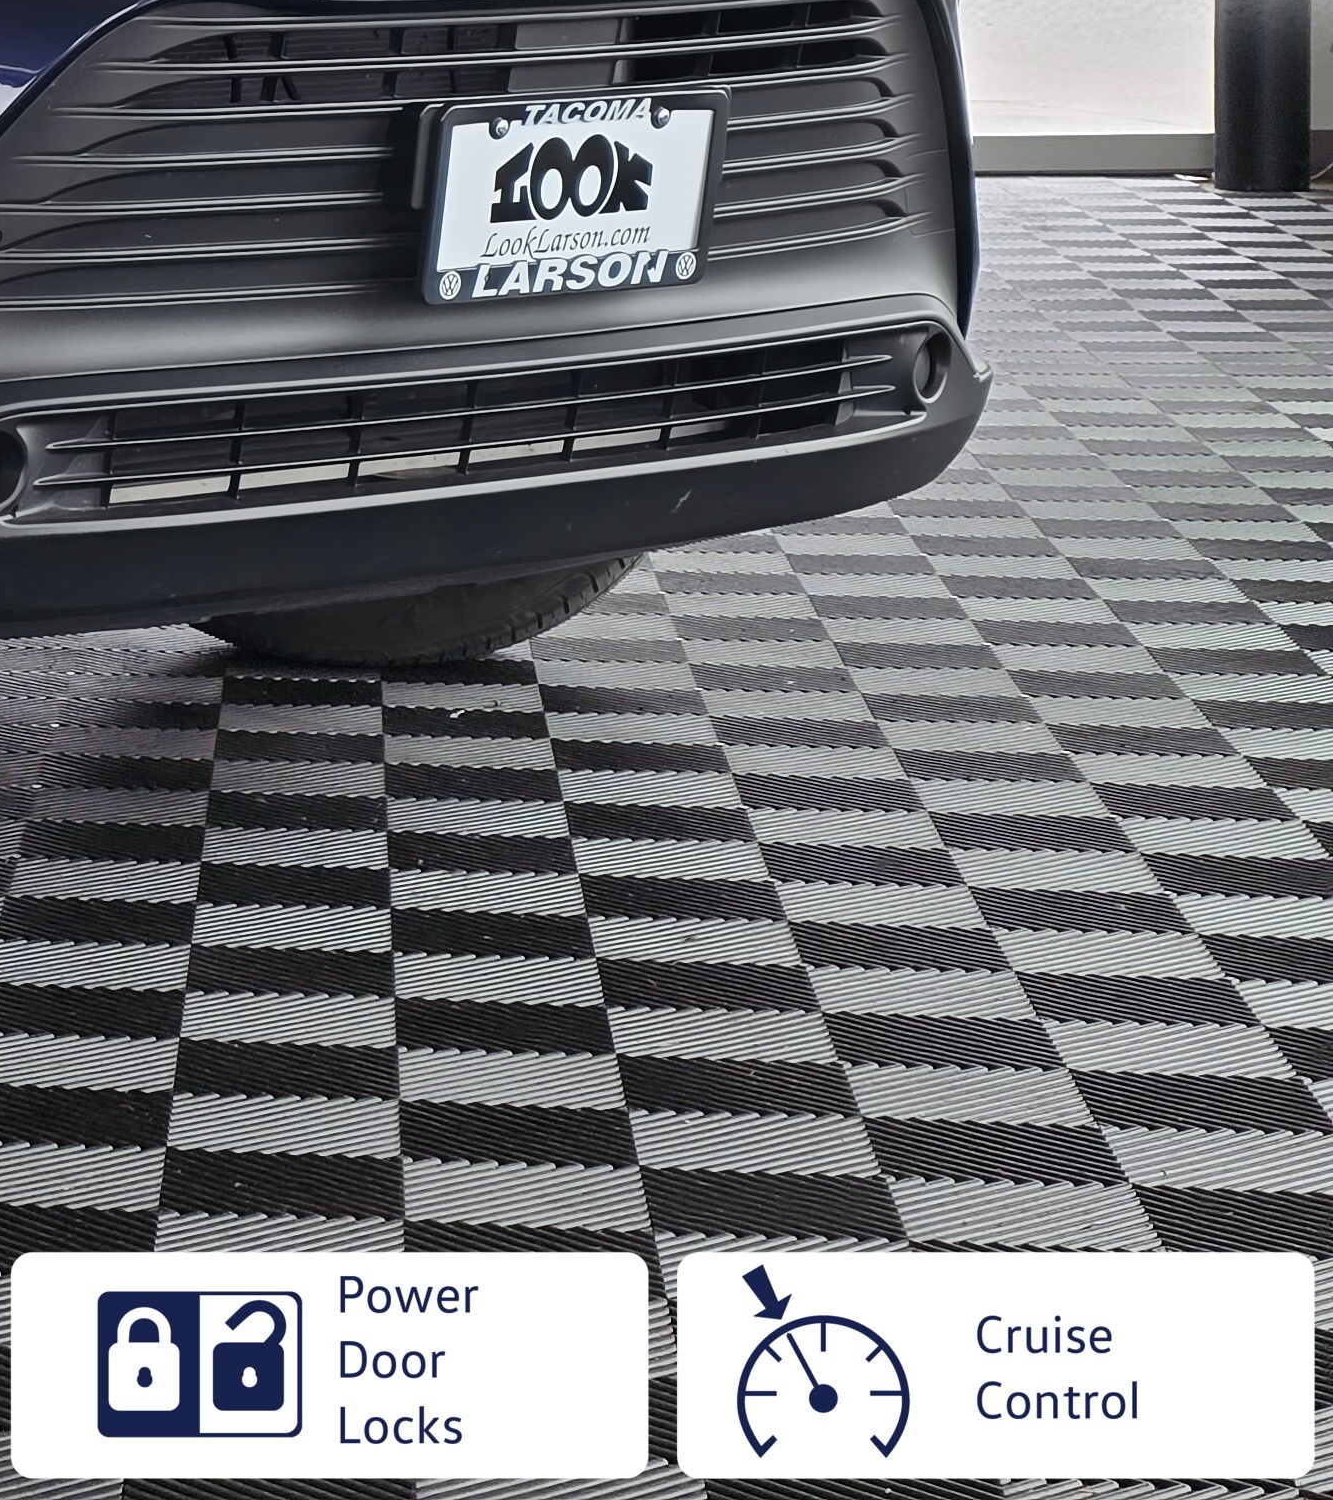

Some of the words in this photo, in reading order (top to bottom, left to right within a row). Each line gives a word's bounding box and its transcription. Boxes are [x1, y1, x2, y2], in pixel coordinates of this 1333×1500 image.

[521, 98, 652, 127] TACOMA
[489, 133, 654, 224] LOOK
[480, 225, 652, 260] LookLarson.com
[471, 250, 669, 298] LARSON
